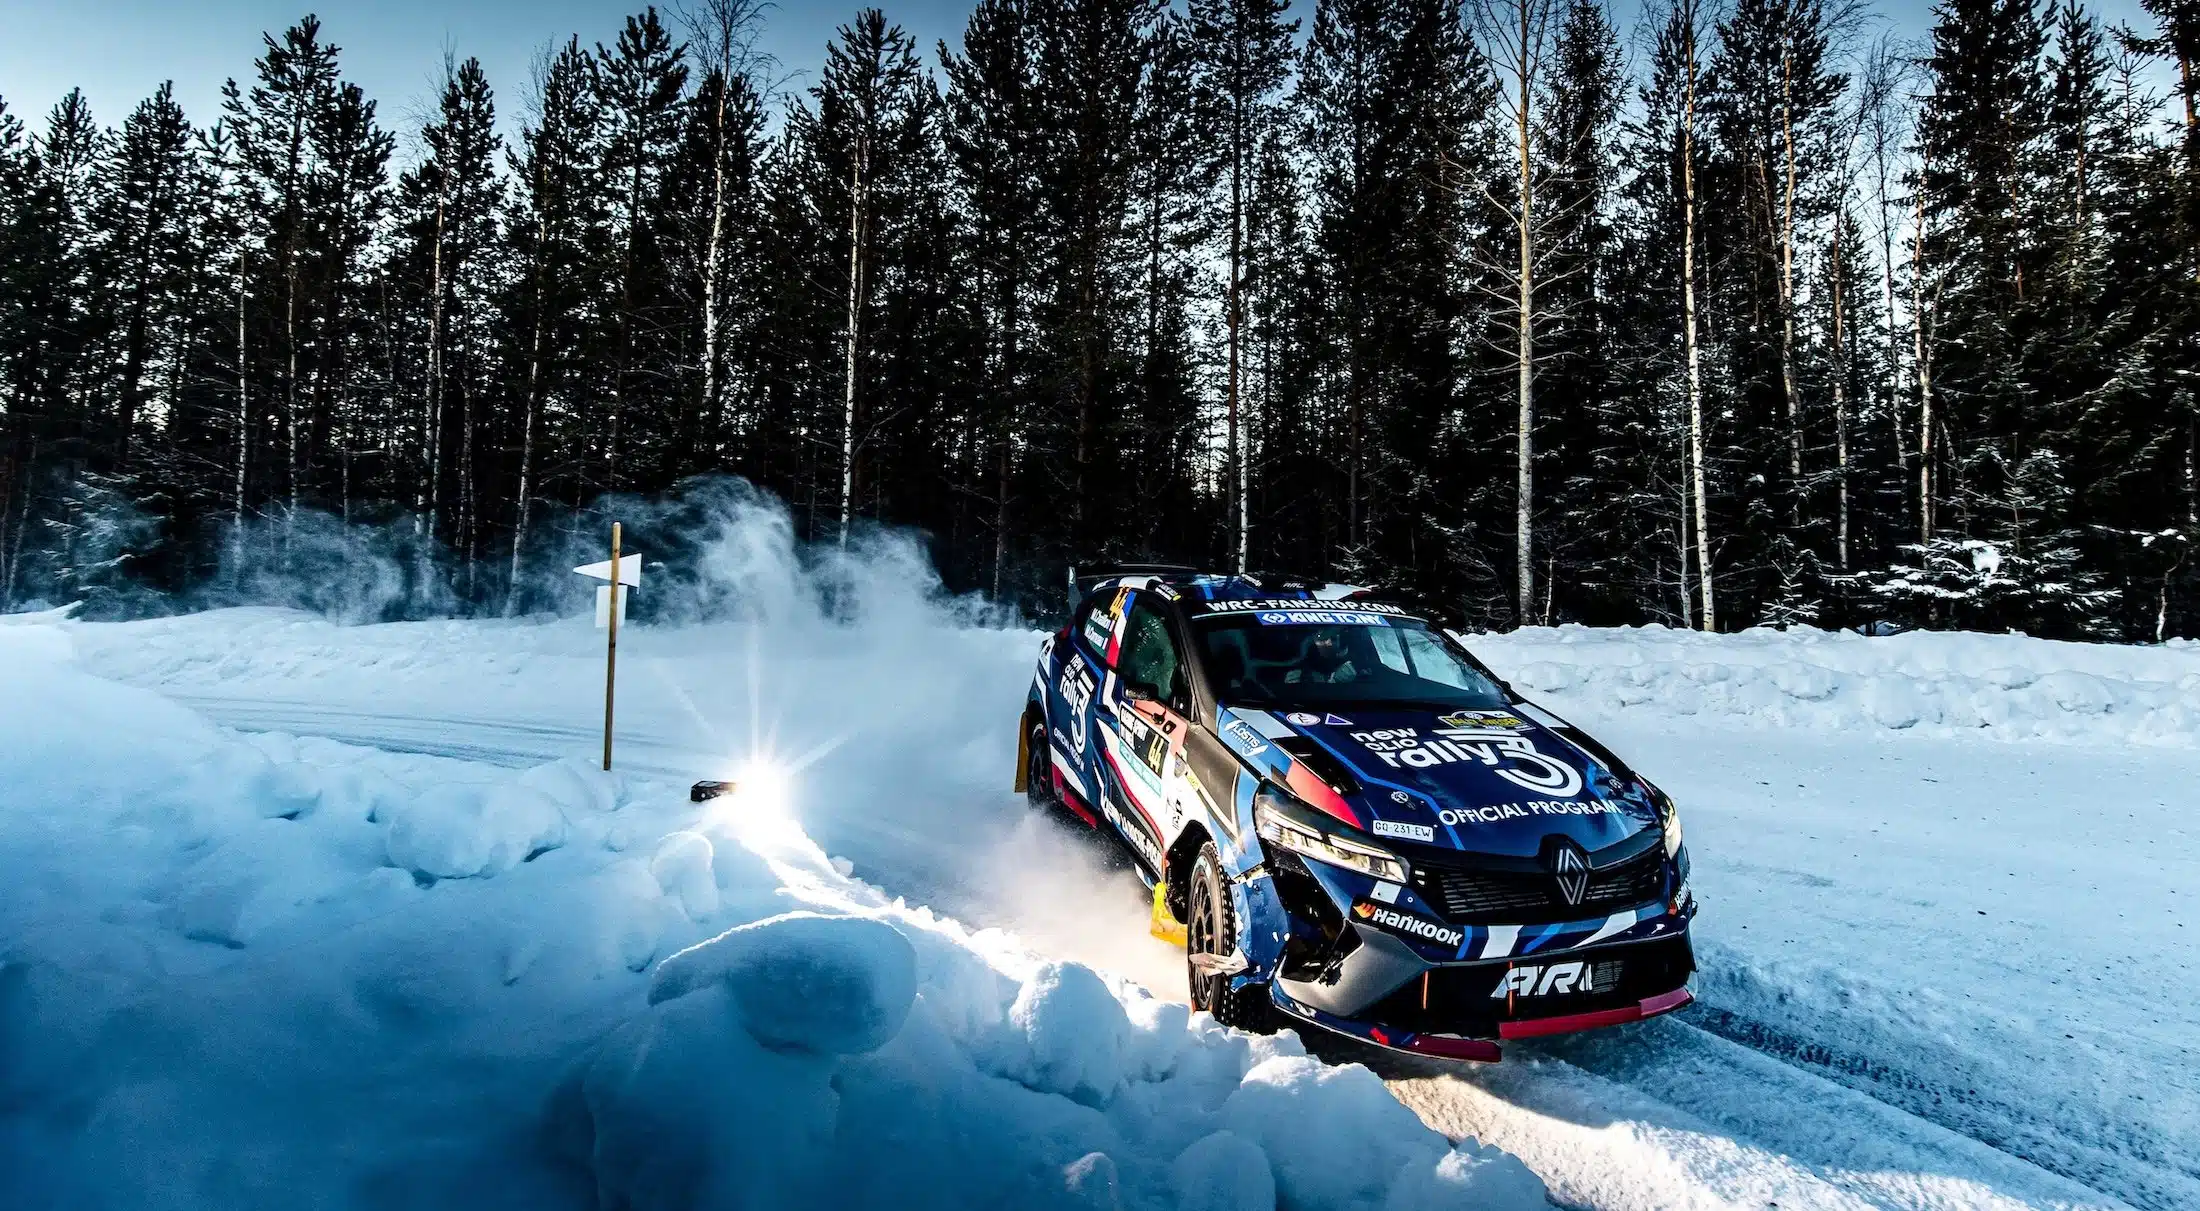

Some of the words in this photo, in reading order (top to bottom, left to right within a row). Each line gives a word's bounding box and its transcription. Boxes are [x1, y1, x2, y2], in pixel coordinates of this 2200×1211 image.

[1206, 600, 1406, 615] WRC-FANSHOP.COM
[1060, 674, 1080, 716] rally
[1350, 727, 1418, 743] new
[1365, 739, 1419, 752] CLIO
[1148, 734, 1164, 774] 44
[1375, 740, 1499, 768] rally
[1438, 801, 1529, 827] OFFICIAL
[1527, 800, 1623, 816] PROGRAM
